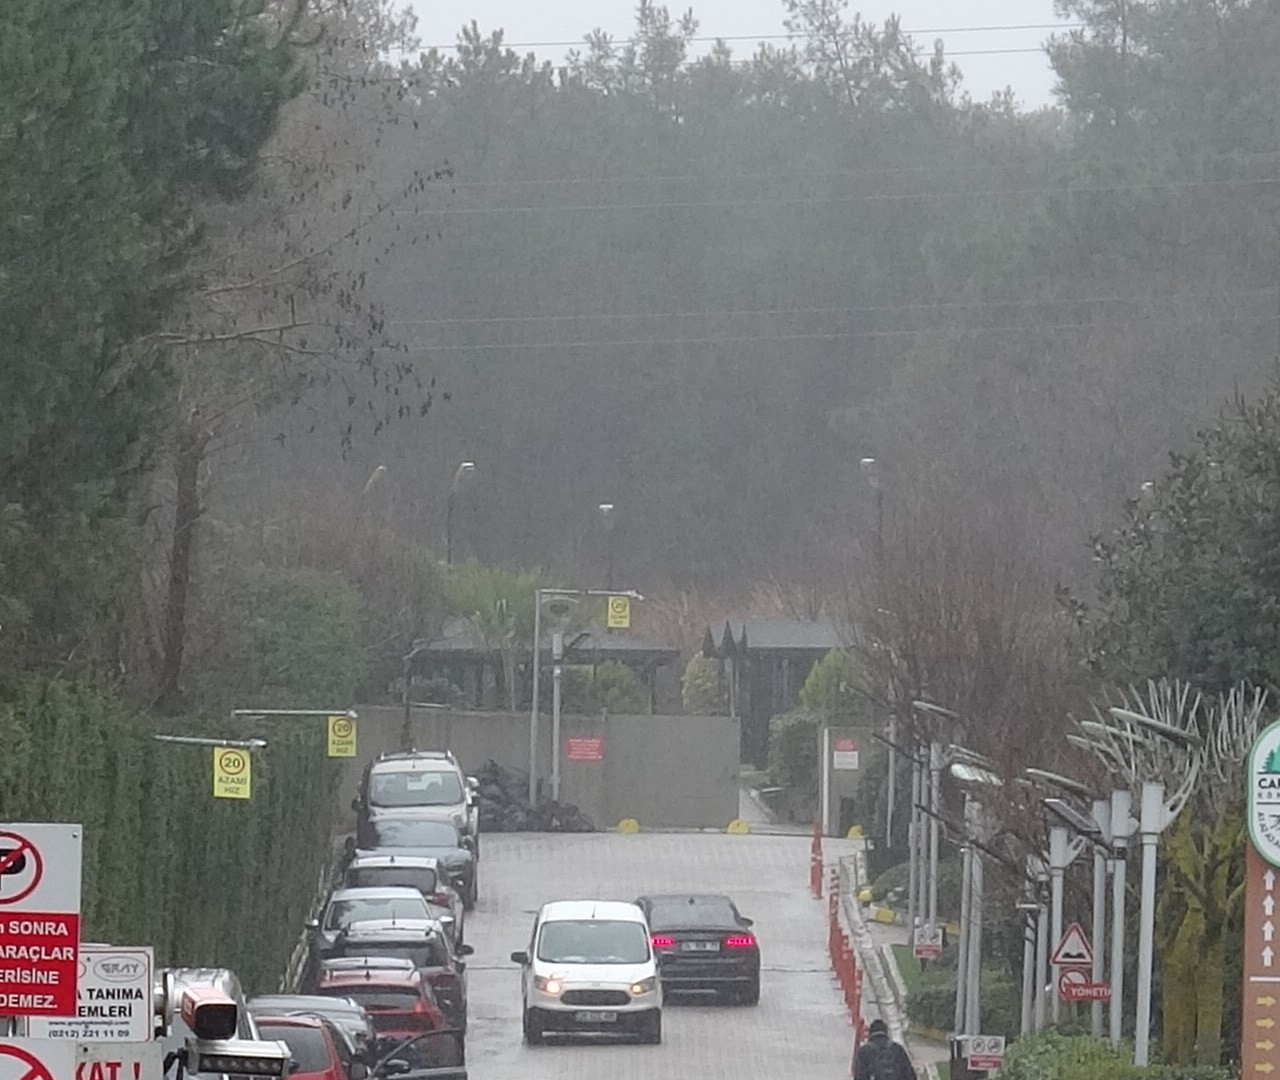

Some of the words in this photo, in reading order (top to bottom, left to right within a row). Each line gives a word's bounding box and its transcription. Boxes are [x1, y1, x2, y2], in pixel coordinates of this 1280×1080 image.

[224, 757, 240, 768] 20
[9, 921, 68, 936] SONRA
[86, 988, 144, 1000] TANIMA
